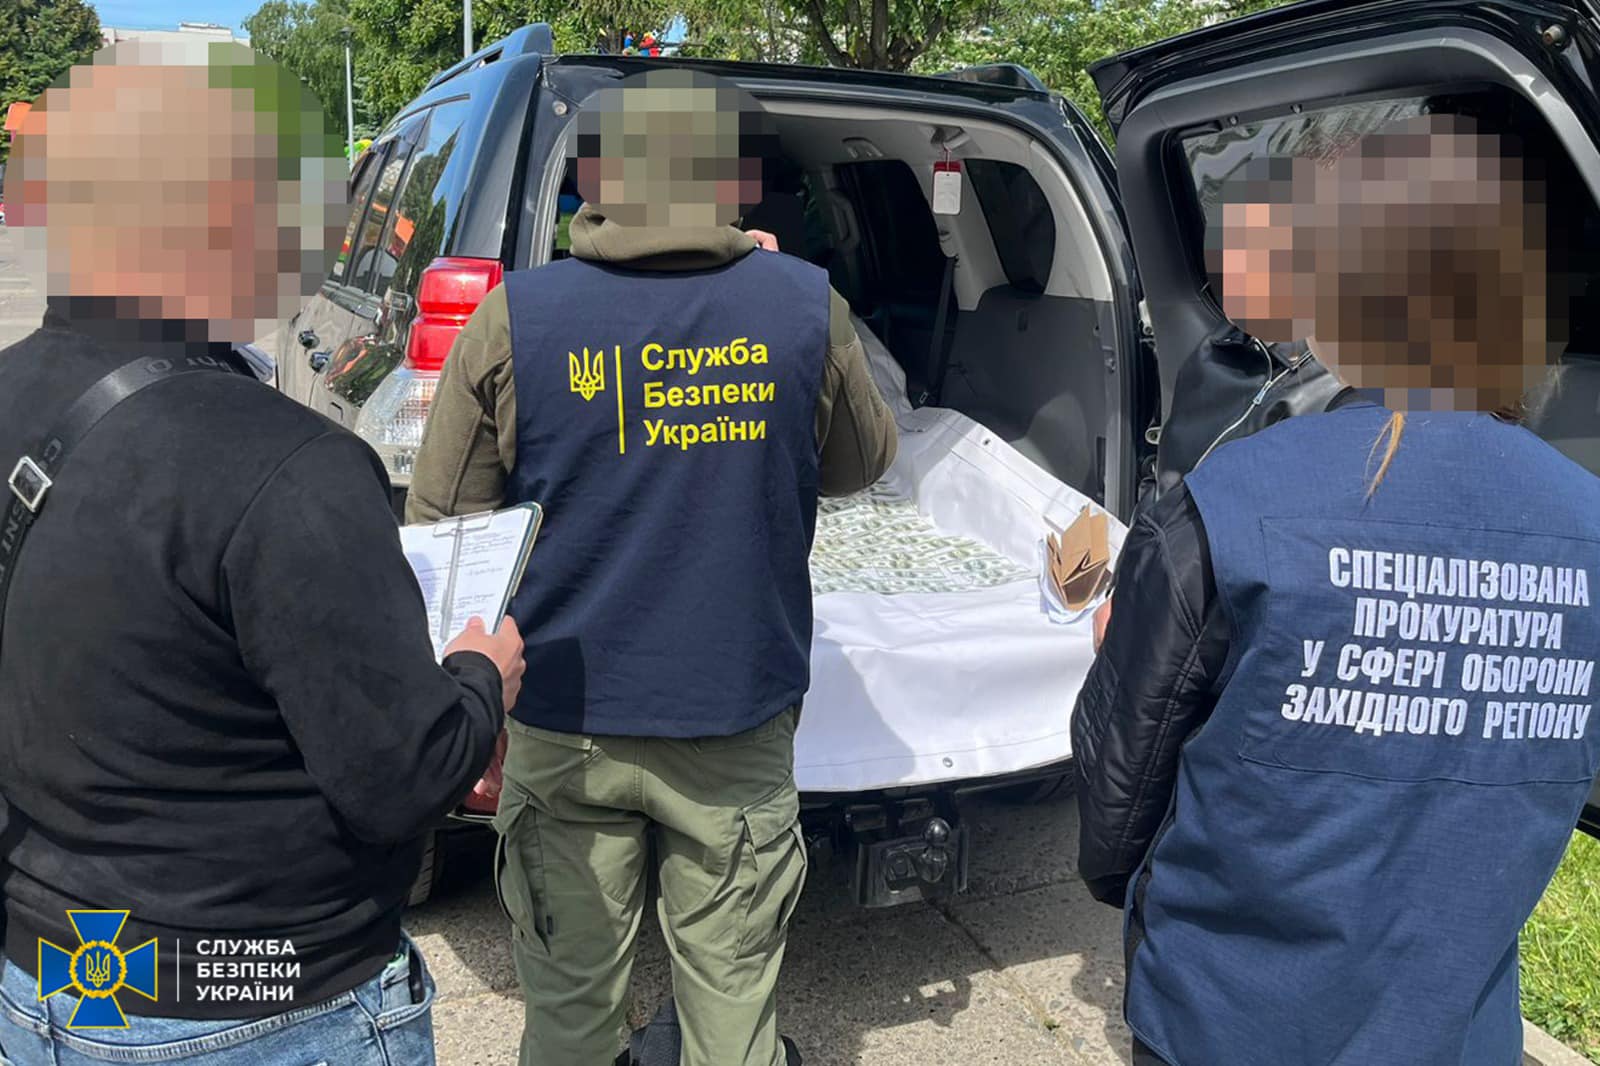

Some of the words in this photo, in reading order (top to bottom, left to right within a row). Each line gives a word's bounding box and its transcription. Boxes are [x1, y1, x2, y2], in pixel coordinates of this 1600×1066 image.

[641, 336, 769, 375] Служба
[643, 381, 776, 409] Безпеки
[643, 415, 767, 451] України
[1328, 546, 1590, 607] СПЕЦІАЛІЗОВАНА
[1353, 597, 1564, 650] ПРОКУРАТУРА
[1300, 639, 1325, 678] У
[1336, 643, 1447, 689] СФЕРІ
[1461, 652, 1595, 697] ОБОРОНИ
[1280, 683, 1468, 737] ЗАХІДНОГО
[1482, 700, 1592, 740] РЕГІОНУ
